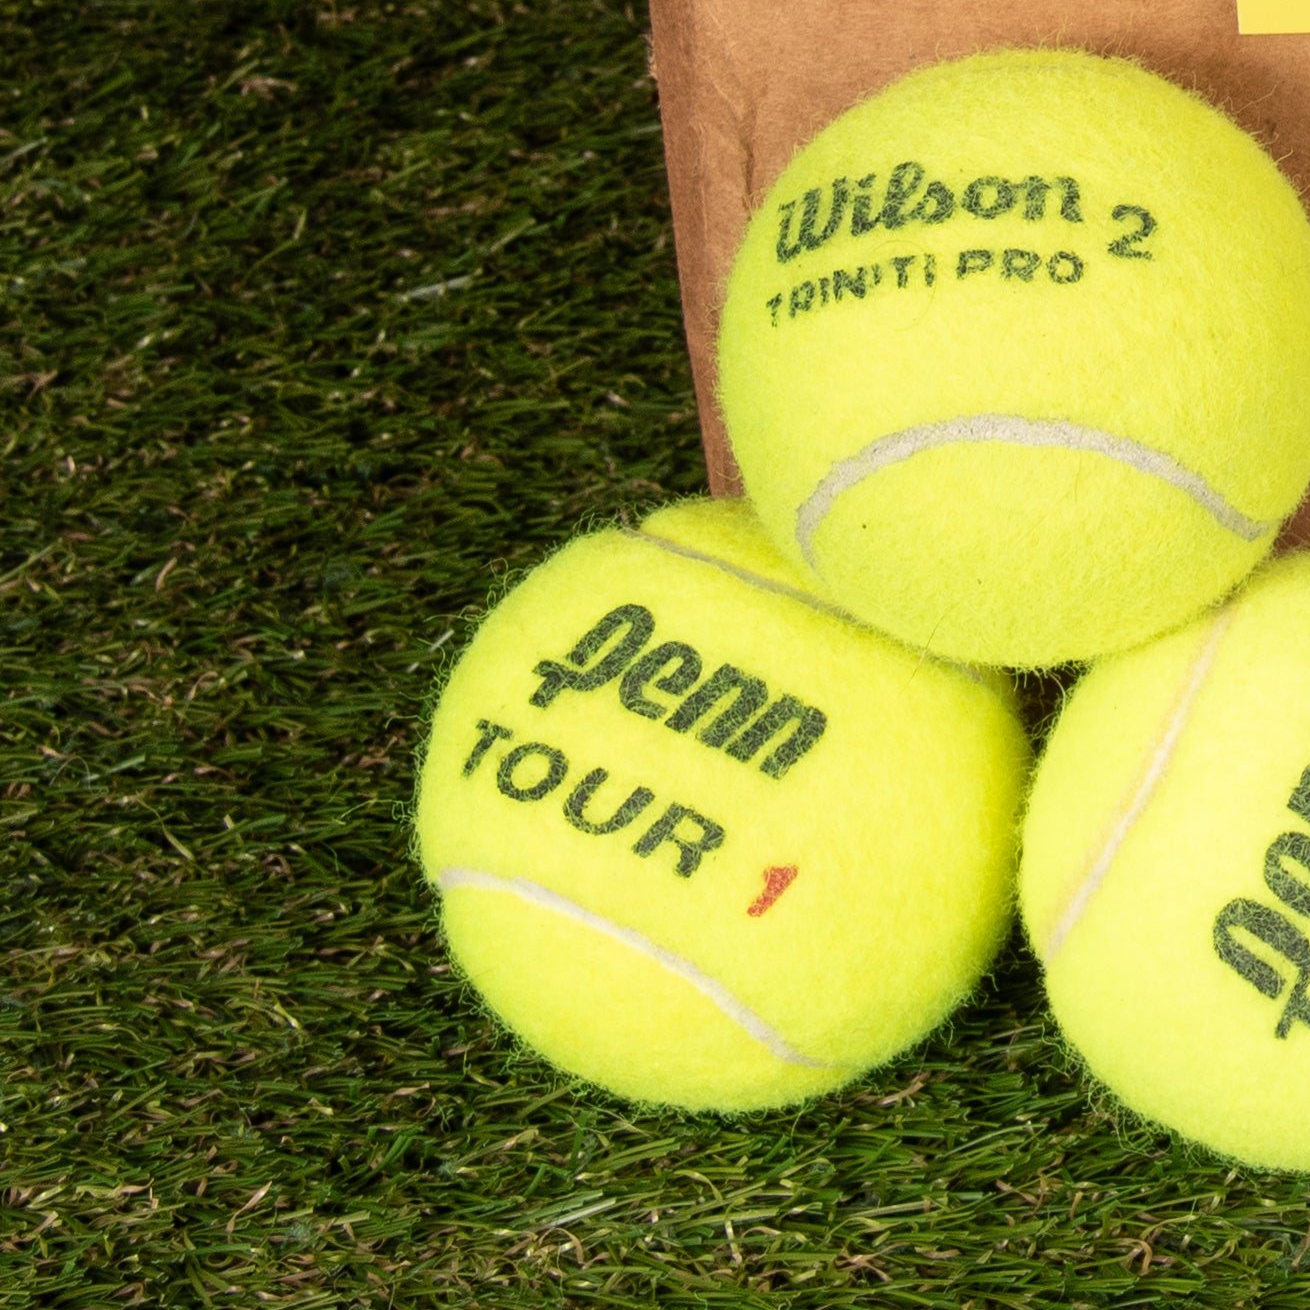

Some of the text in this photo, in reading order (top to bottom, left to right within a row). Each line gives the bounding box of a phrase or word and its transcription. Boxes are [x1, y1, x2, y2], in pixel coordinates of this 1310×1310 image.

[775, 160, 1158, 265] Wilson 2
[956, 248, 1084, 284] PRO
[460, 718, 800, 918] TOUR 1
